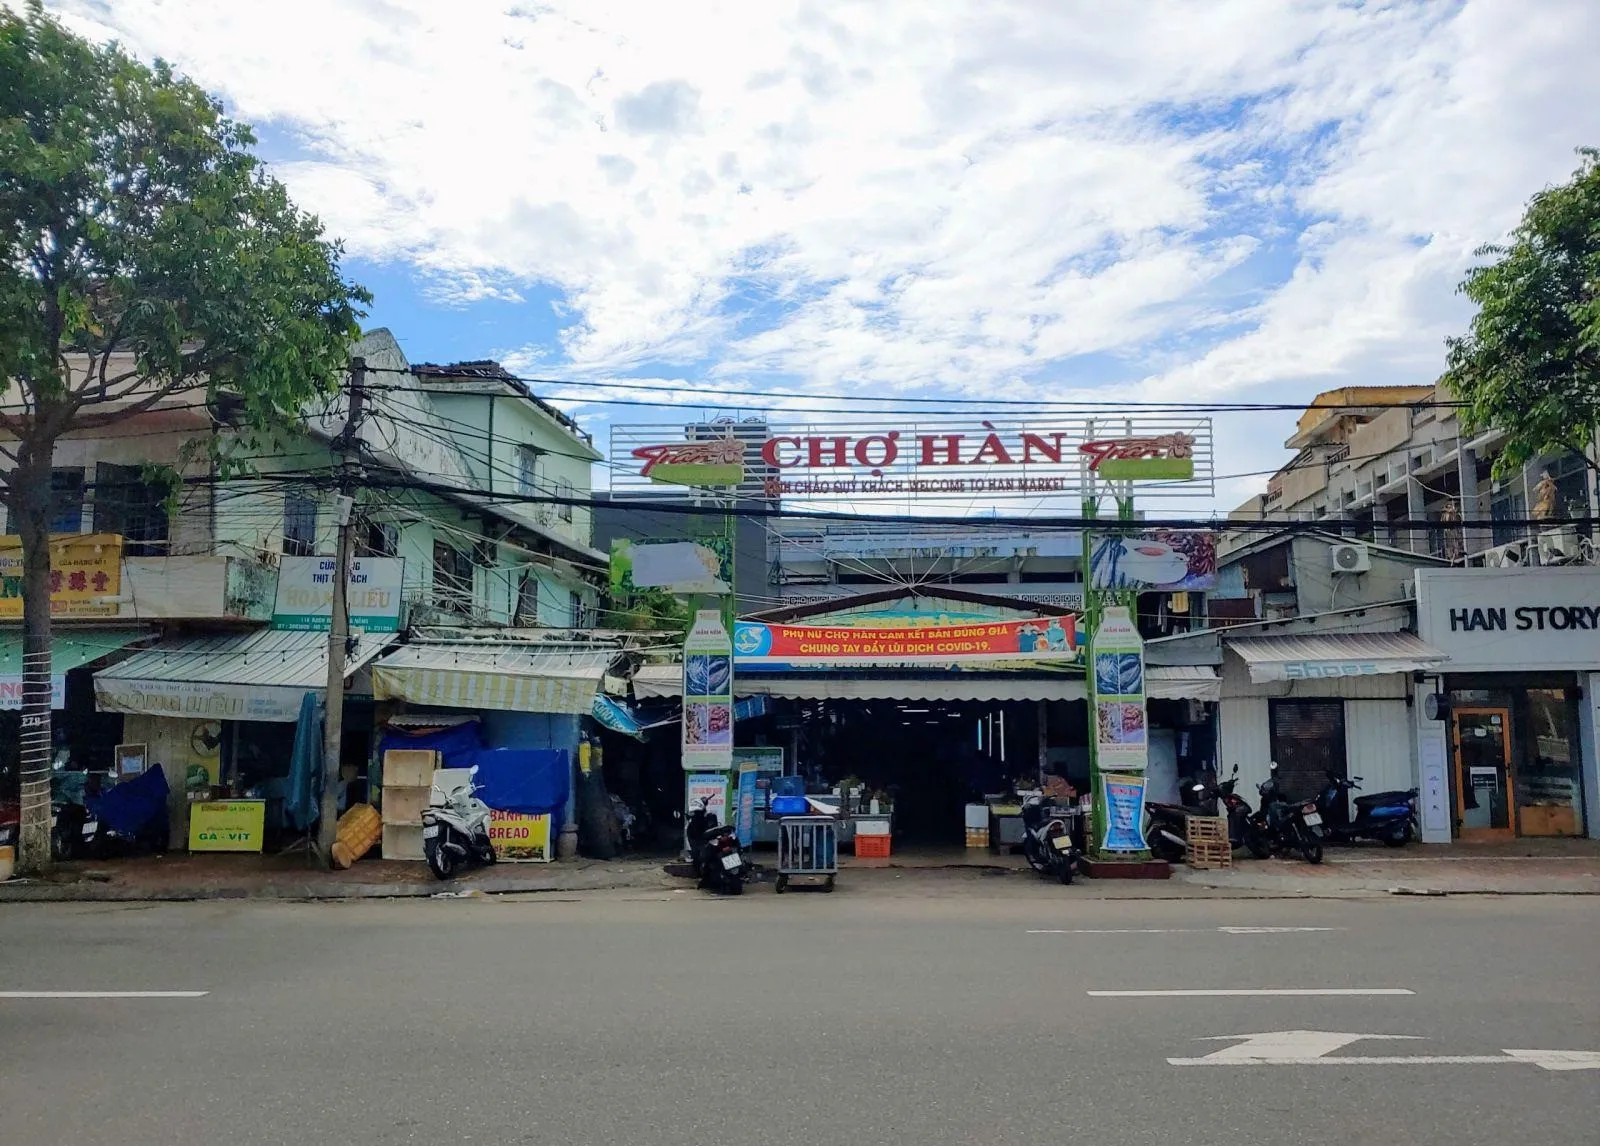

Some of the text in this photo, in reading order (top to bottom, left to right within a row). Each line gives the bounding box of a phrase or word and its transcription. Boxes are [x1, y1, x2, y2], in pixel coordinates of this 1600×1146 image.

[761, 421, 1068, 477] CHỢ HÀN
[909, 479, 965, 492] WELCOME
[970, 478, 985, 492] TO
[989, 477, 1013, 491] HAN
[1018, 476, 1065, 491] MARKET
[312, 574, 329, 585] THỊT
[350, 574, 368, 586] ẠCH
[1449, 606, 1600, 631] HAN STORY
[799, 643, 840, 653] CHUNG
[842, 643, 861, 653] TAY
[489, 827, 529, 839] BREAD
